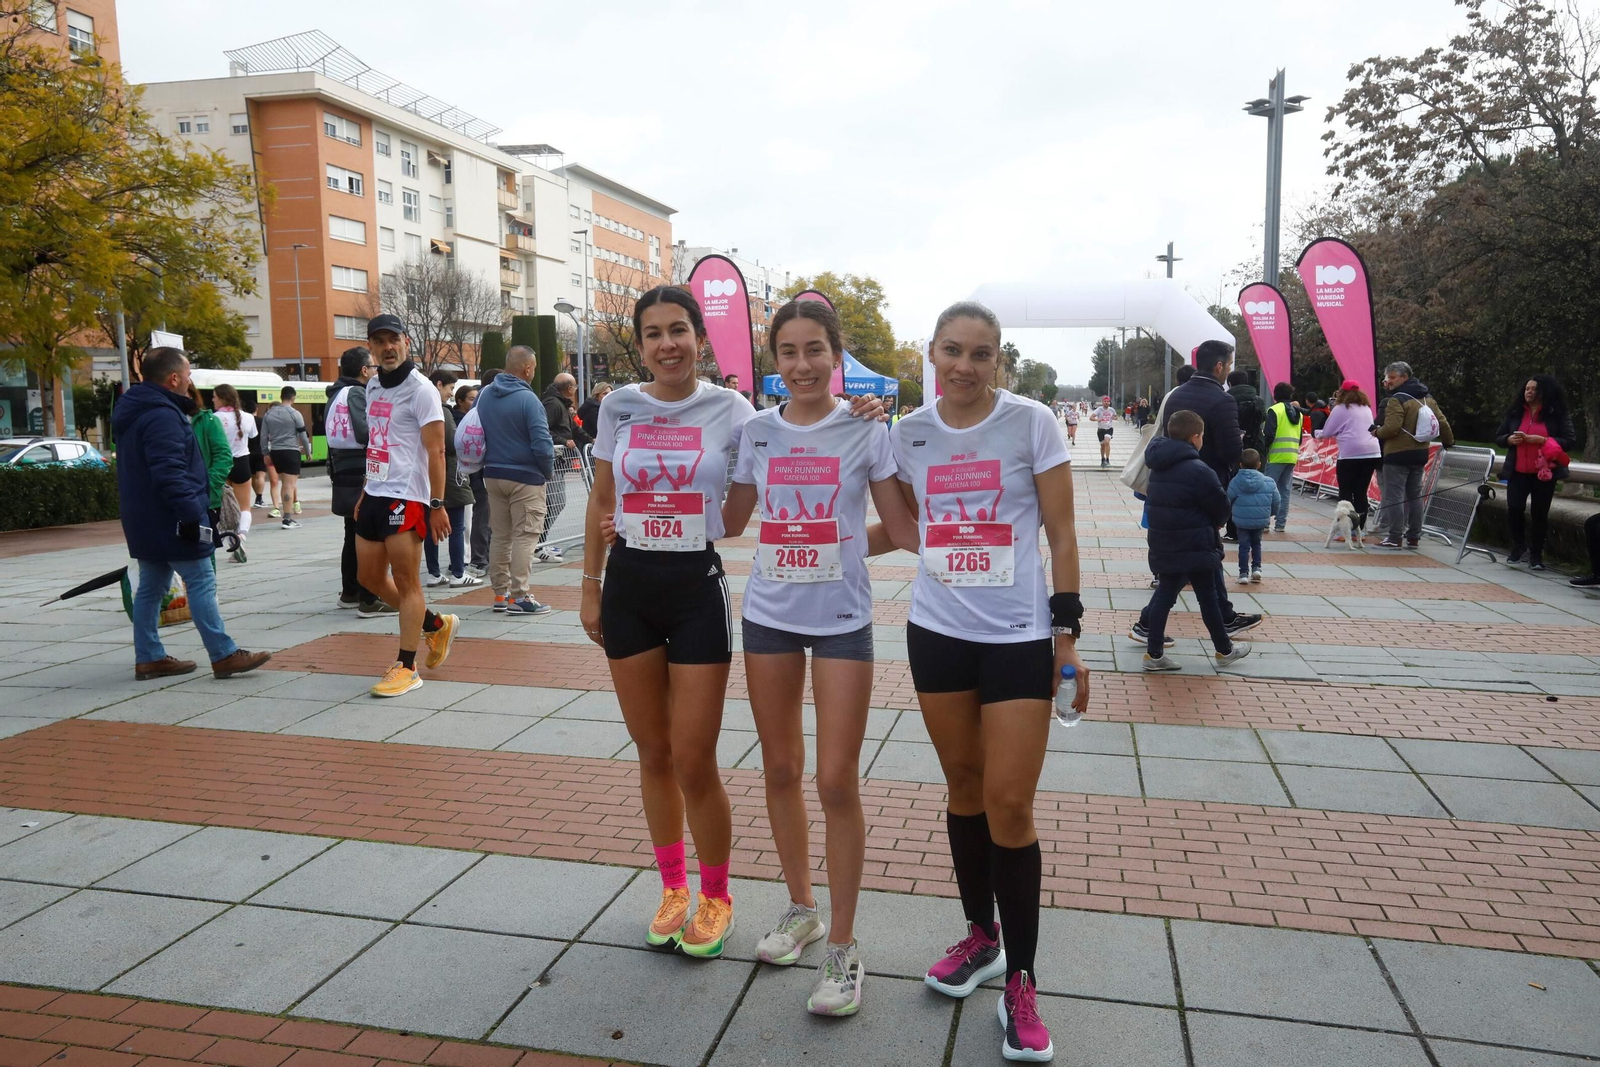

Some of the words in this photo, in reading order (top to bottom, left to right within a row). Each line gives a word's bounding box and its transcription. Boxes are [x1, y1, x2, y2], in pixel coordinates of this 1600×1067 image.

[1316, 265, 1356, 285] 100
[704, 278, 737, 298] 100
[955, 471, 992, 481] RUNNING
[641, 520, 683, 538] 1624
[775, 548, 819, 568] 2482
[945, 552, 991, 572] 1265
